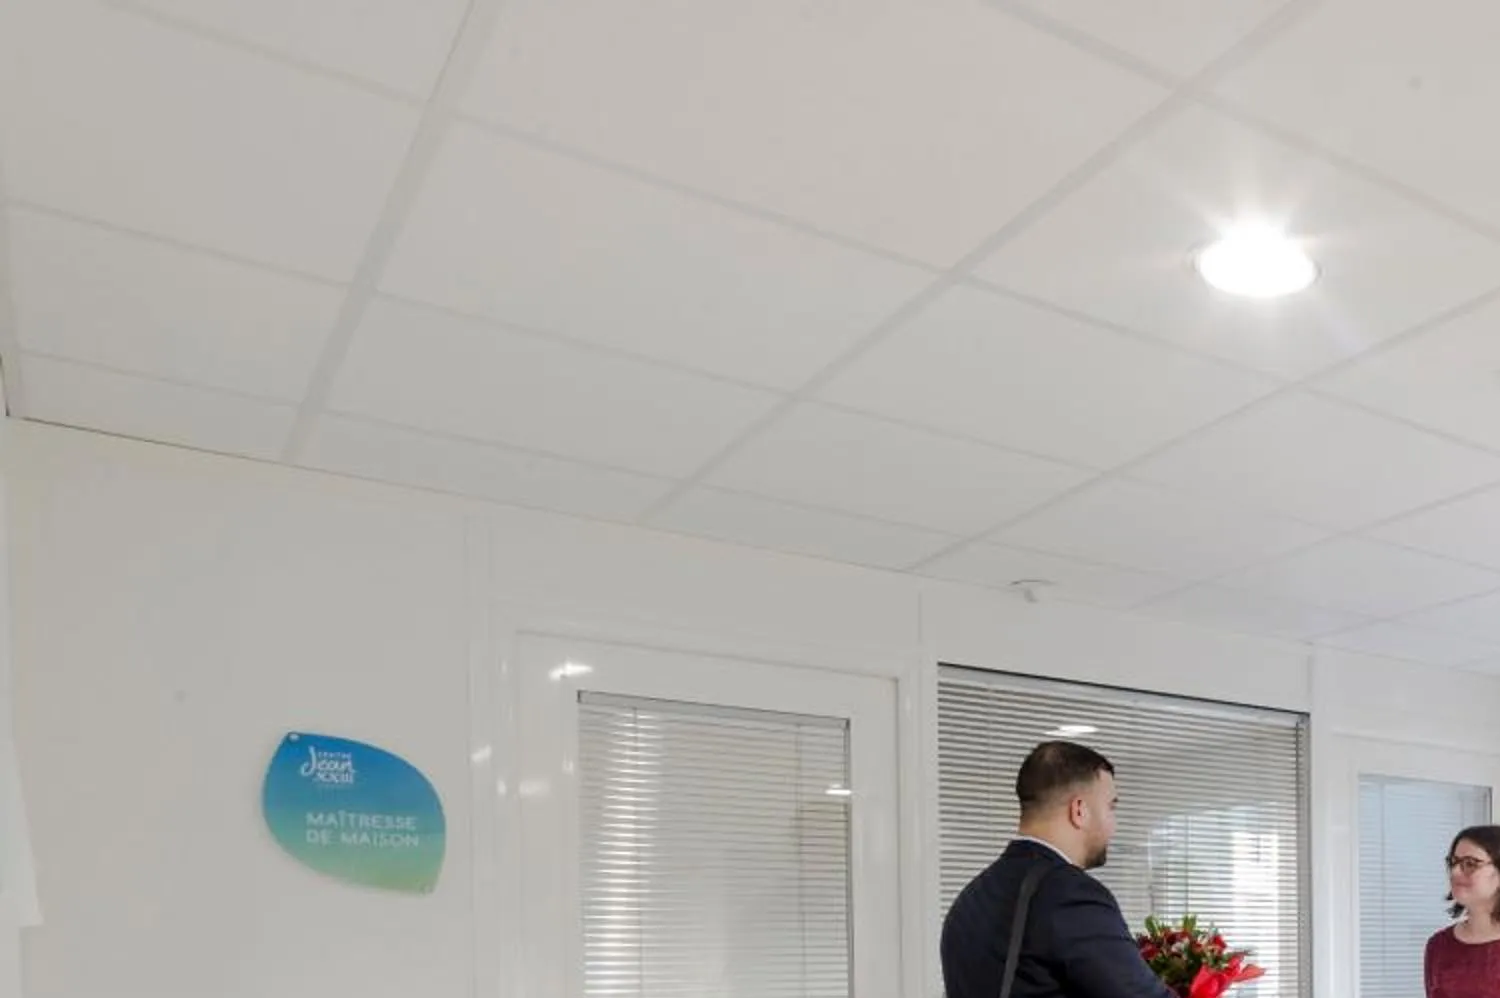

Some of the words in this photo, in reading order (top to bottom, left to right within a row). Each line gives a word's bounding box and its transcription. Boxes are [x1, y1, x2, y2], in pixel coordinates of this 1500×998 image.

[305, 810, 419, 831] MAÎTRESSE
[306, 829, 332, 847] DE
[341, 831, 420, 849] MAISON
